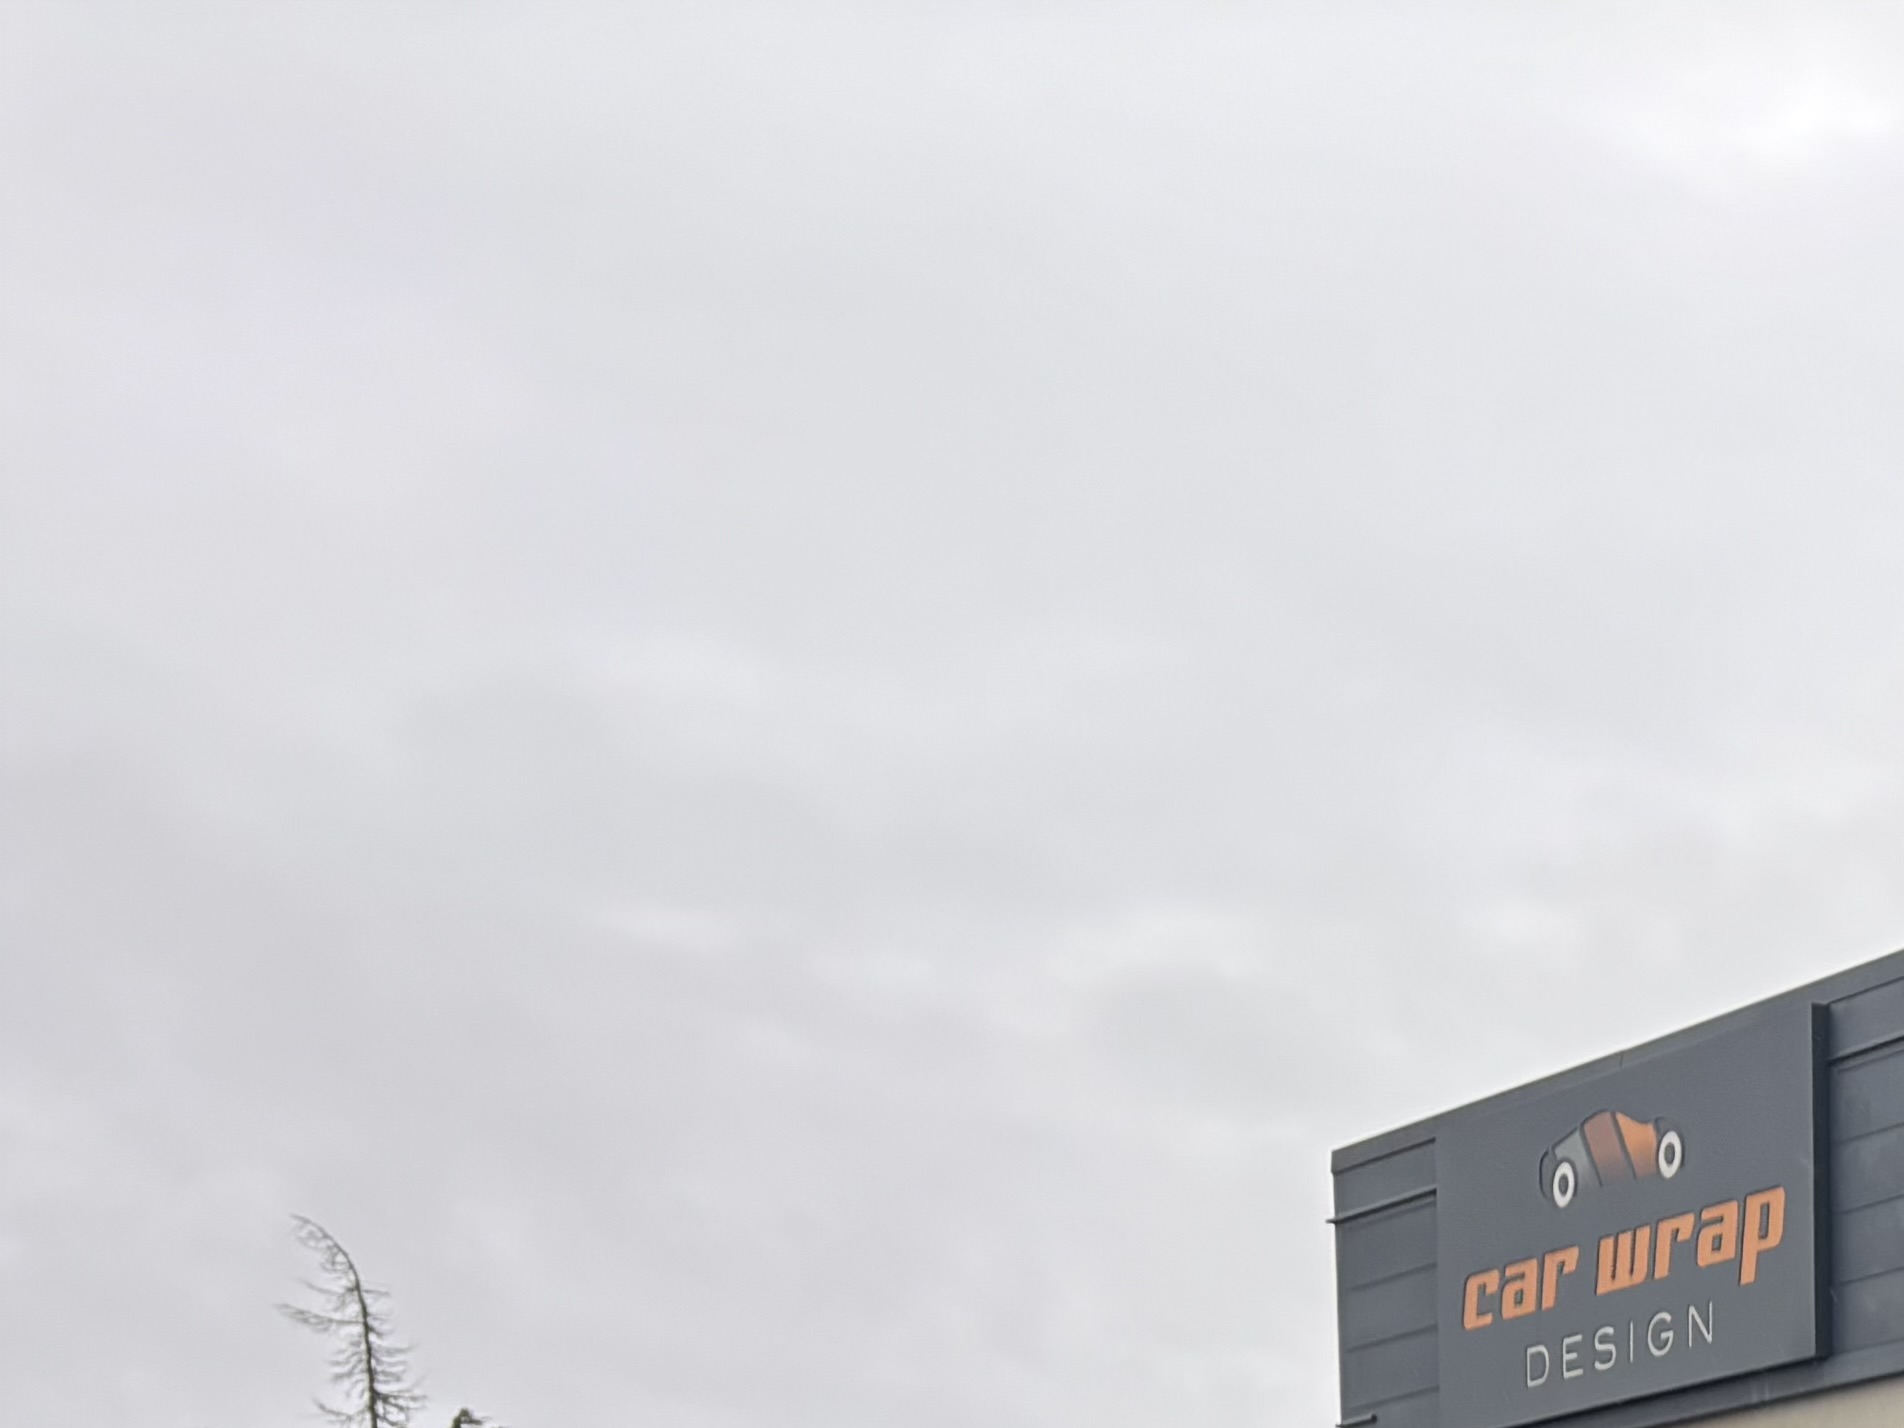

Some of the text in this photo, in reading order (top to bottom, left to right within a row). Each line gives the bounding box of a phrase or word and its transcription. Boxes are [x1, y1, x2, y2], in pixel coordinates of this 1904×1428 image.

[1462, 1185, 1786, 1332] car wrap
[1526, 1301, 1713, 1388] DESIGN
